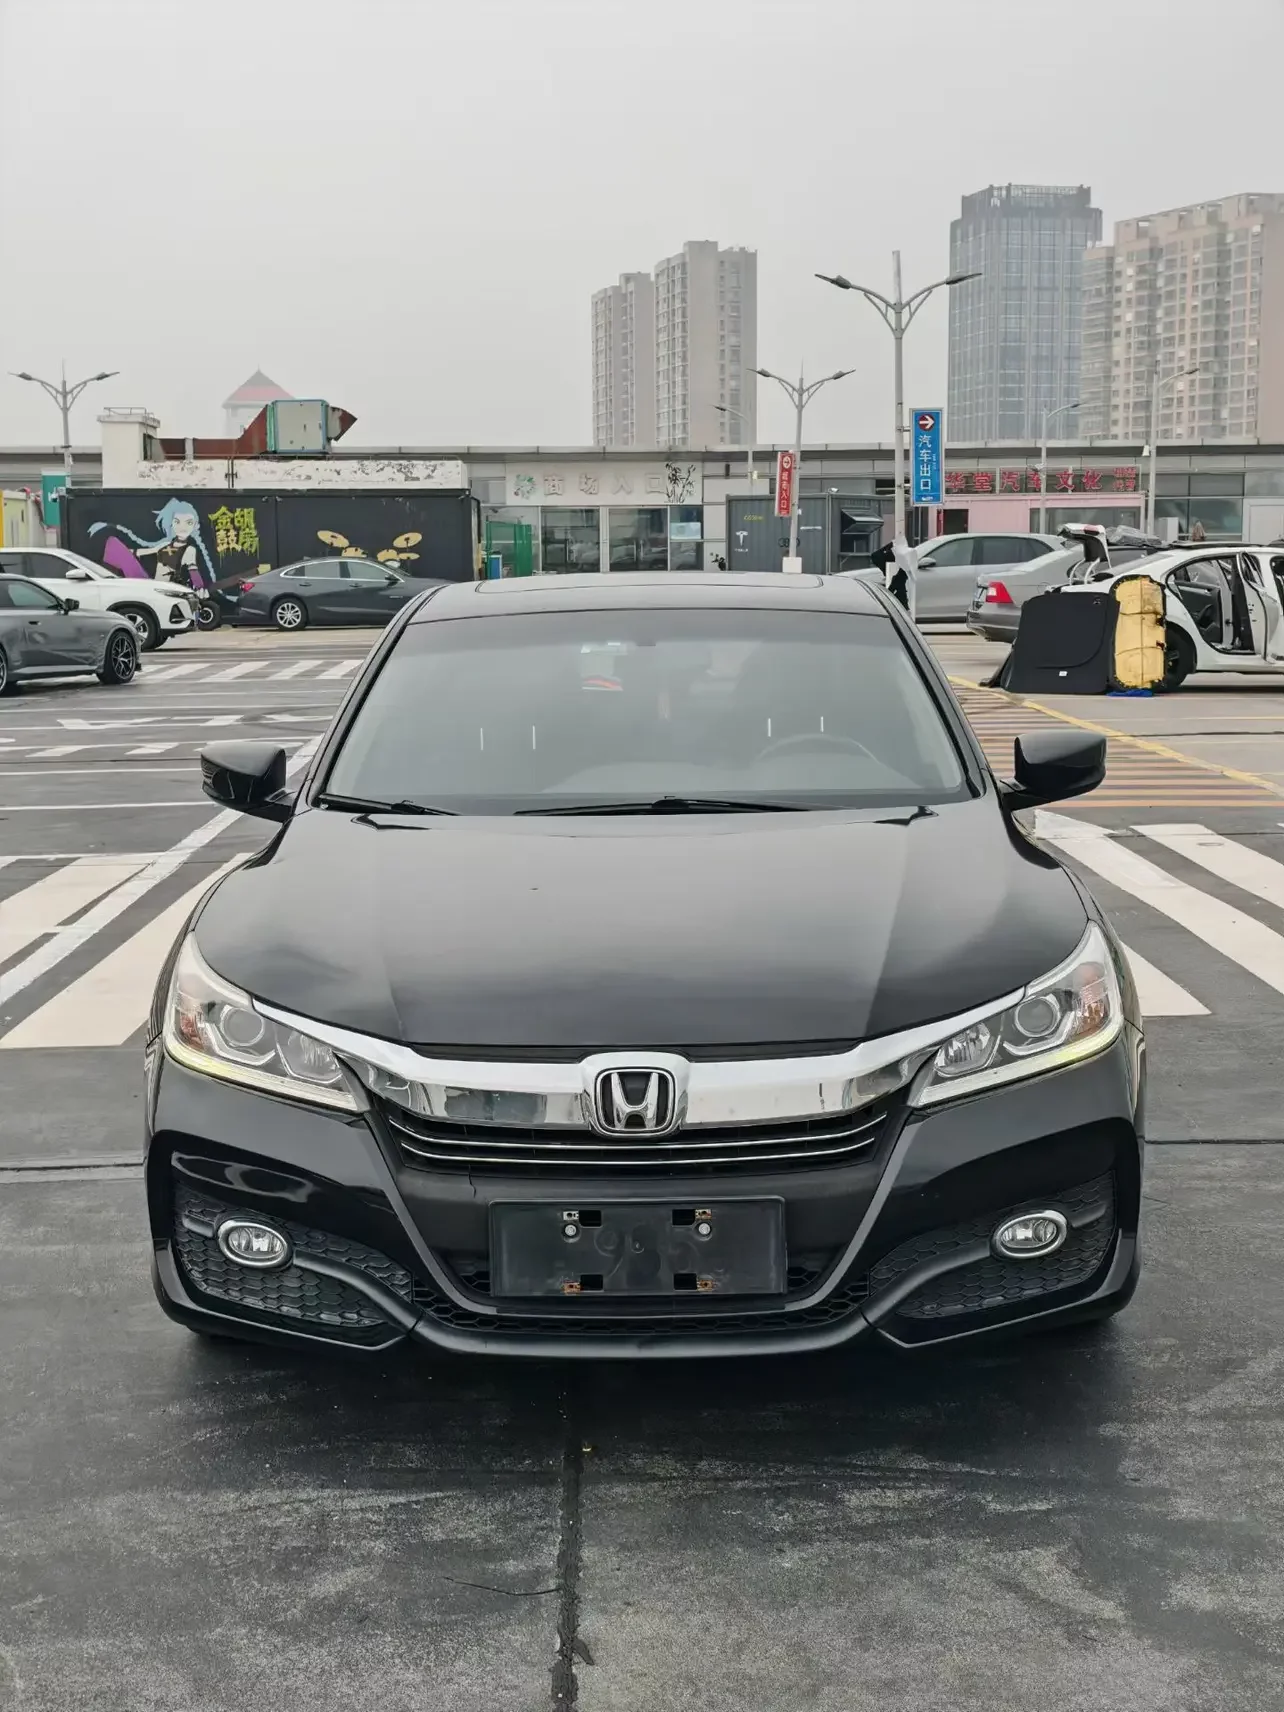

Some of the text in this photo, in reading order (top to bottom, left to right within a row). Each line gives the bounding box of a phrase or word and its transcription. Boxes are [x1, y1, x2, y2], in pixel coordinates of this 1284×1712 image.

[918, 434, 932, 490] 汽车出口
[543, 472, 665, 496] 商场入口
